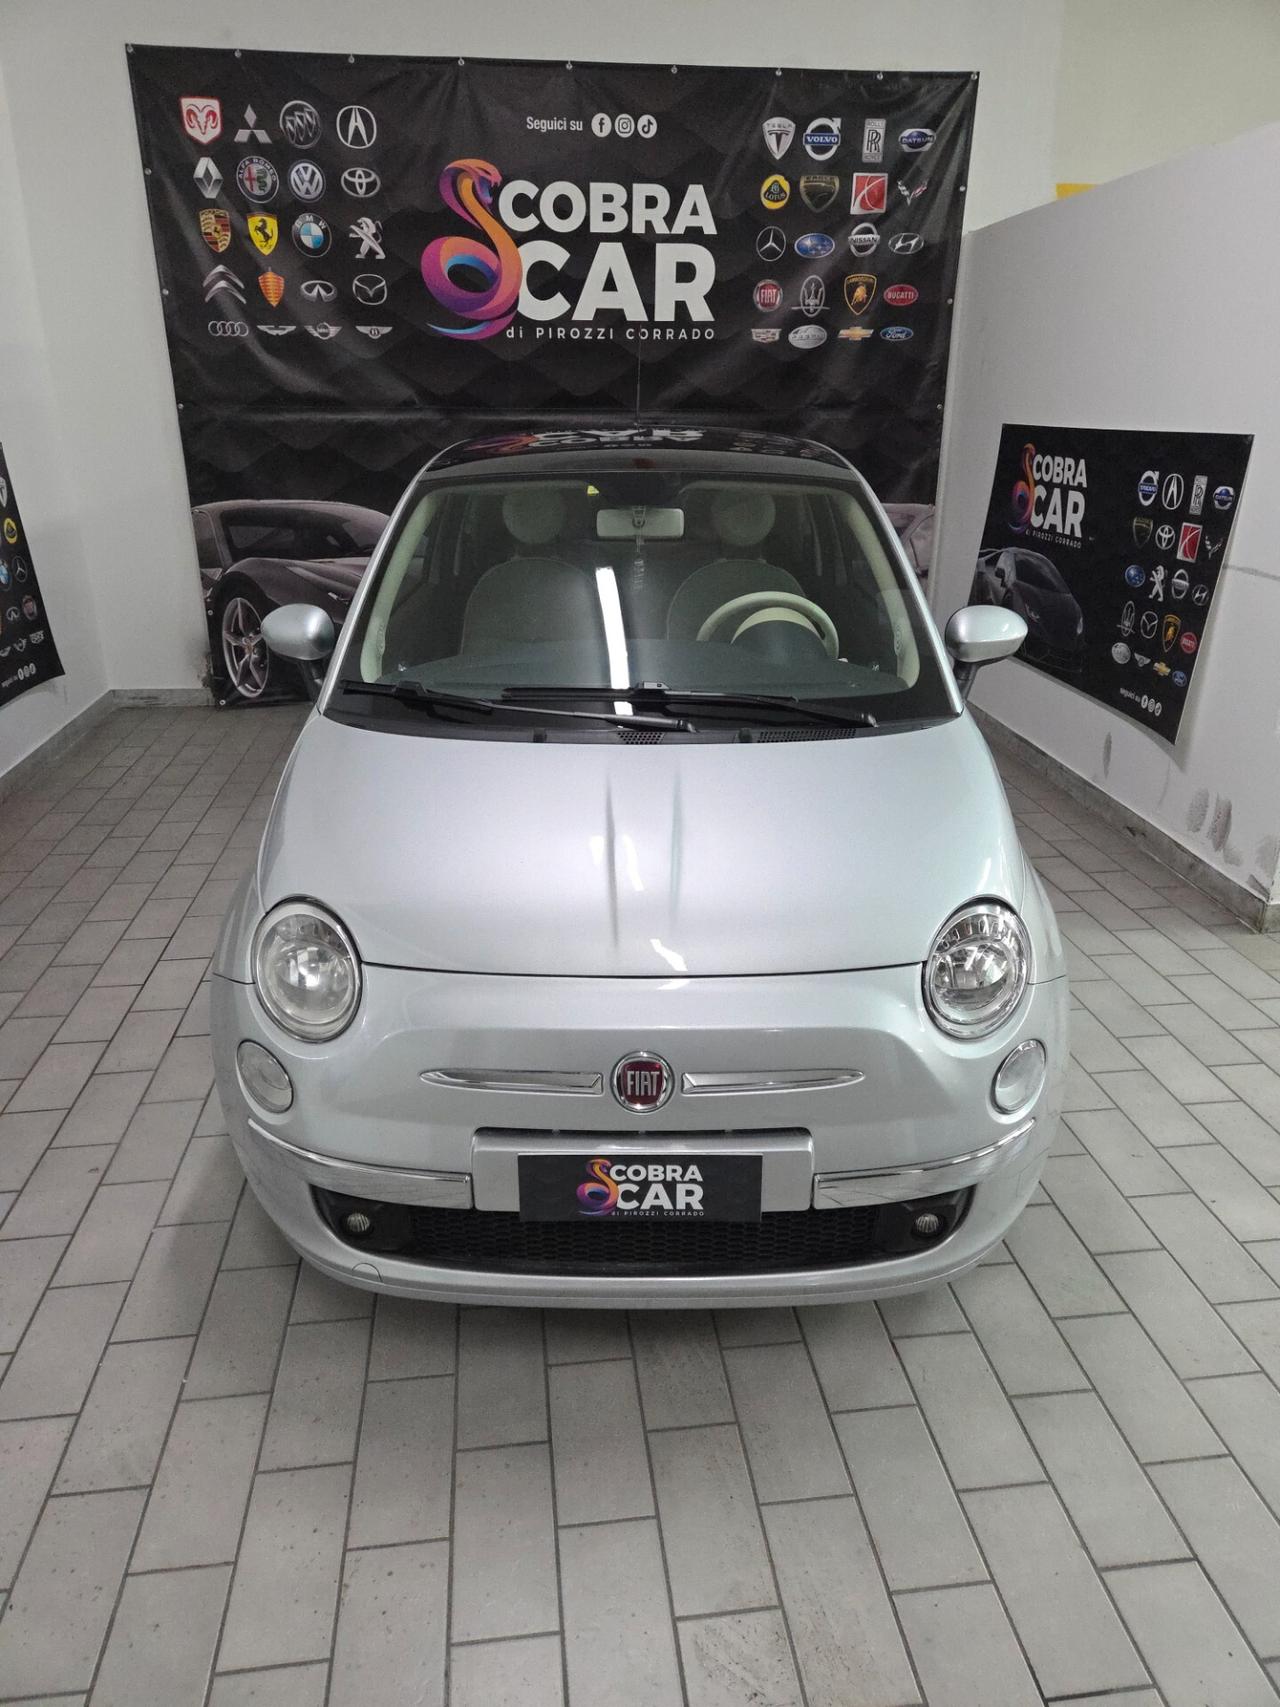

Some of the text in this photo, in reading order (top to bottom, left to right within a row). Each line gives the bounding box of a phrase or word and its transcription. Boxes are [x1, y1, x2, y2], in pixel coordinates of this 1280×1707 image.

[526, 115, 583, 132] Seguici su
[239, 159, 277, 182] ALFA ROMEO
[765, 191, 785, 201] LOTUS
[498, 179, 717, 235] COBRA
[295, 215, 328, 229] BMW
[849, 236, 878, 245] NISSAN
[517, 240, 716, 322] CAR
[760, 288, 777, 302] FIAT
[887, 290, 914, 300] BUGATTI
[506, 325, 715, 340] di PIROZZI CORRADO
[886, 328, 906, 339] Ford
[1032, 454, 1087, 487] COBRA
[1030, 485, 1085, 537] CAR
[627, 1070, 660, 1096] FIAT
[609, 1164, 703, 1182] COBRA
[616, 1183, 704, 1210] CAR
